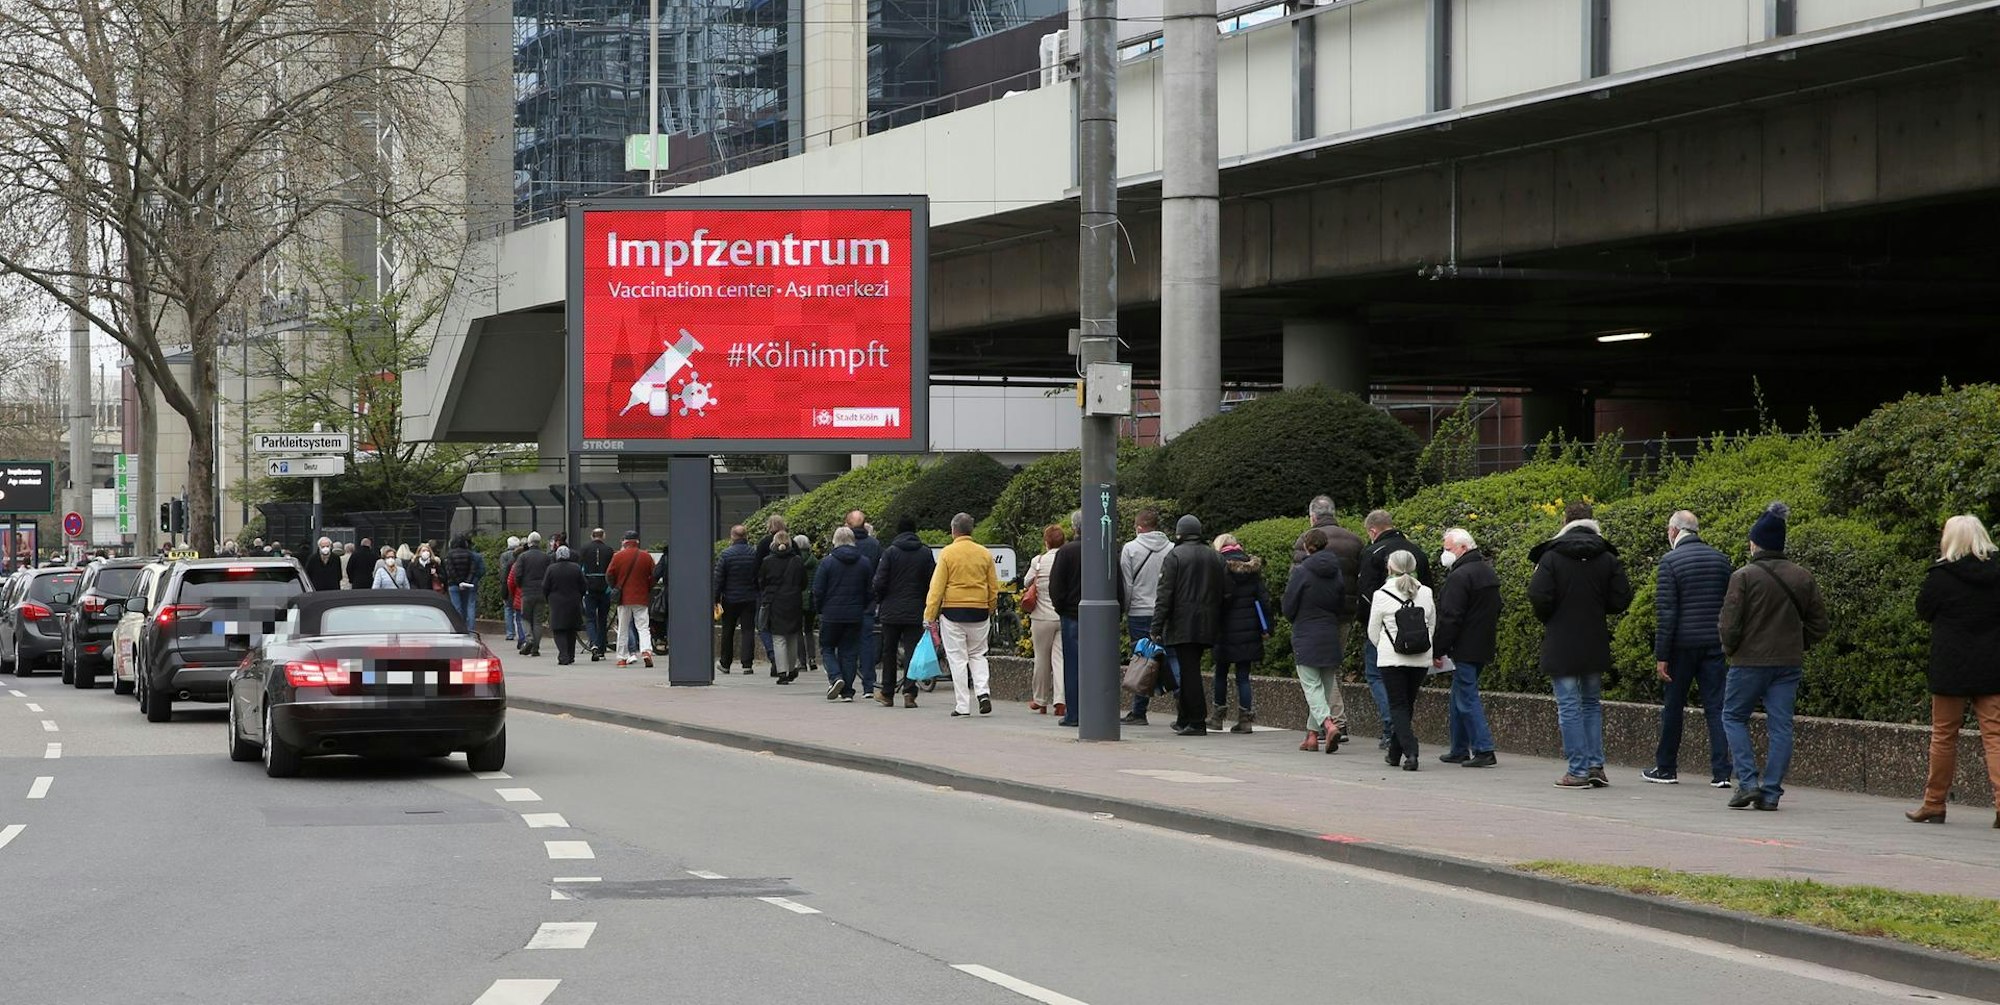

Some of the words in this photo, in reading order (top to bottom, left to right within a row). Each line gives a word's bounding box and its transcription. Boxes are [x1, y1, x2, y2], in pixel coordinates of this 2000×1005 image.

[607, 228, 890, 277] Impfzentrum
[608, 281, 713, 298] Vaccination
[717, 282, 775, 298] center
[784, 281, 812, 299] Aşı
[816, 280, 889, 298] merkezi
[727, 340, 889, 375] #Kölnimpft
[835, 413, 858, 422] Stadt
[859, 412, 879, 422] Köln
[261, 436, 342, 450] Parkleitsystem
[582, 440, 625, 450] STRÖER
